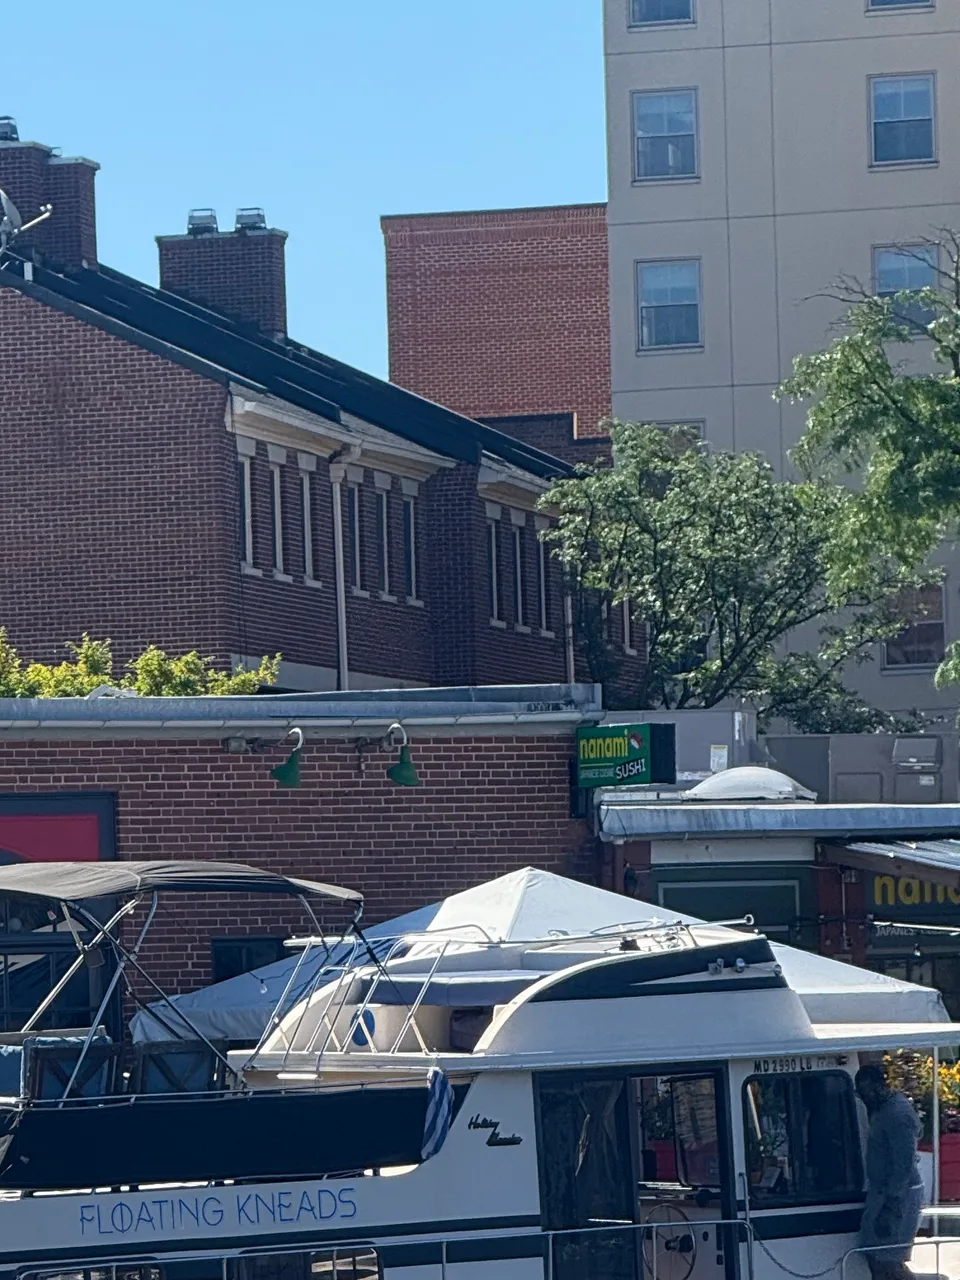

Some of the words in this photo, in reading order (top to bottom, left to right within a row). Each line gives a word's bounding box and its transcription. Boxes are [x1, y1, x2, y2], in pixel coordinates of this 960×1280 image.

[580, 729, 628, 759] nanami
[616, 759, 646, 779] SUSHI
[80, 1196, 224, 1235] FLOATING
[236, 1188, 357, 1225] KNEADS
